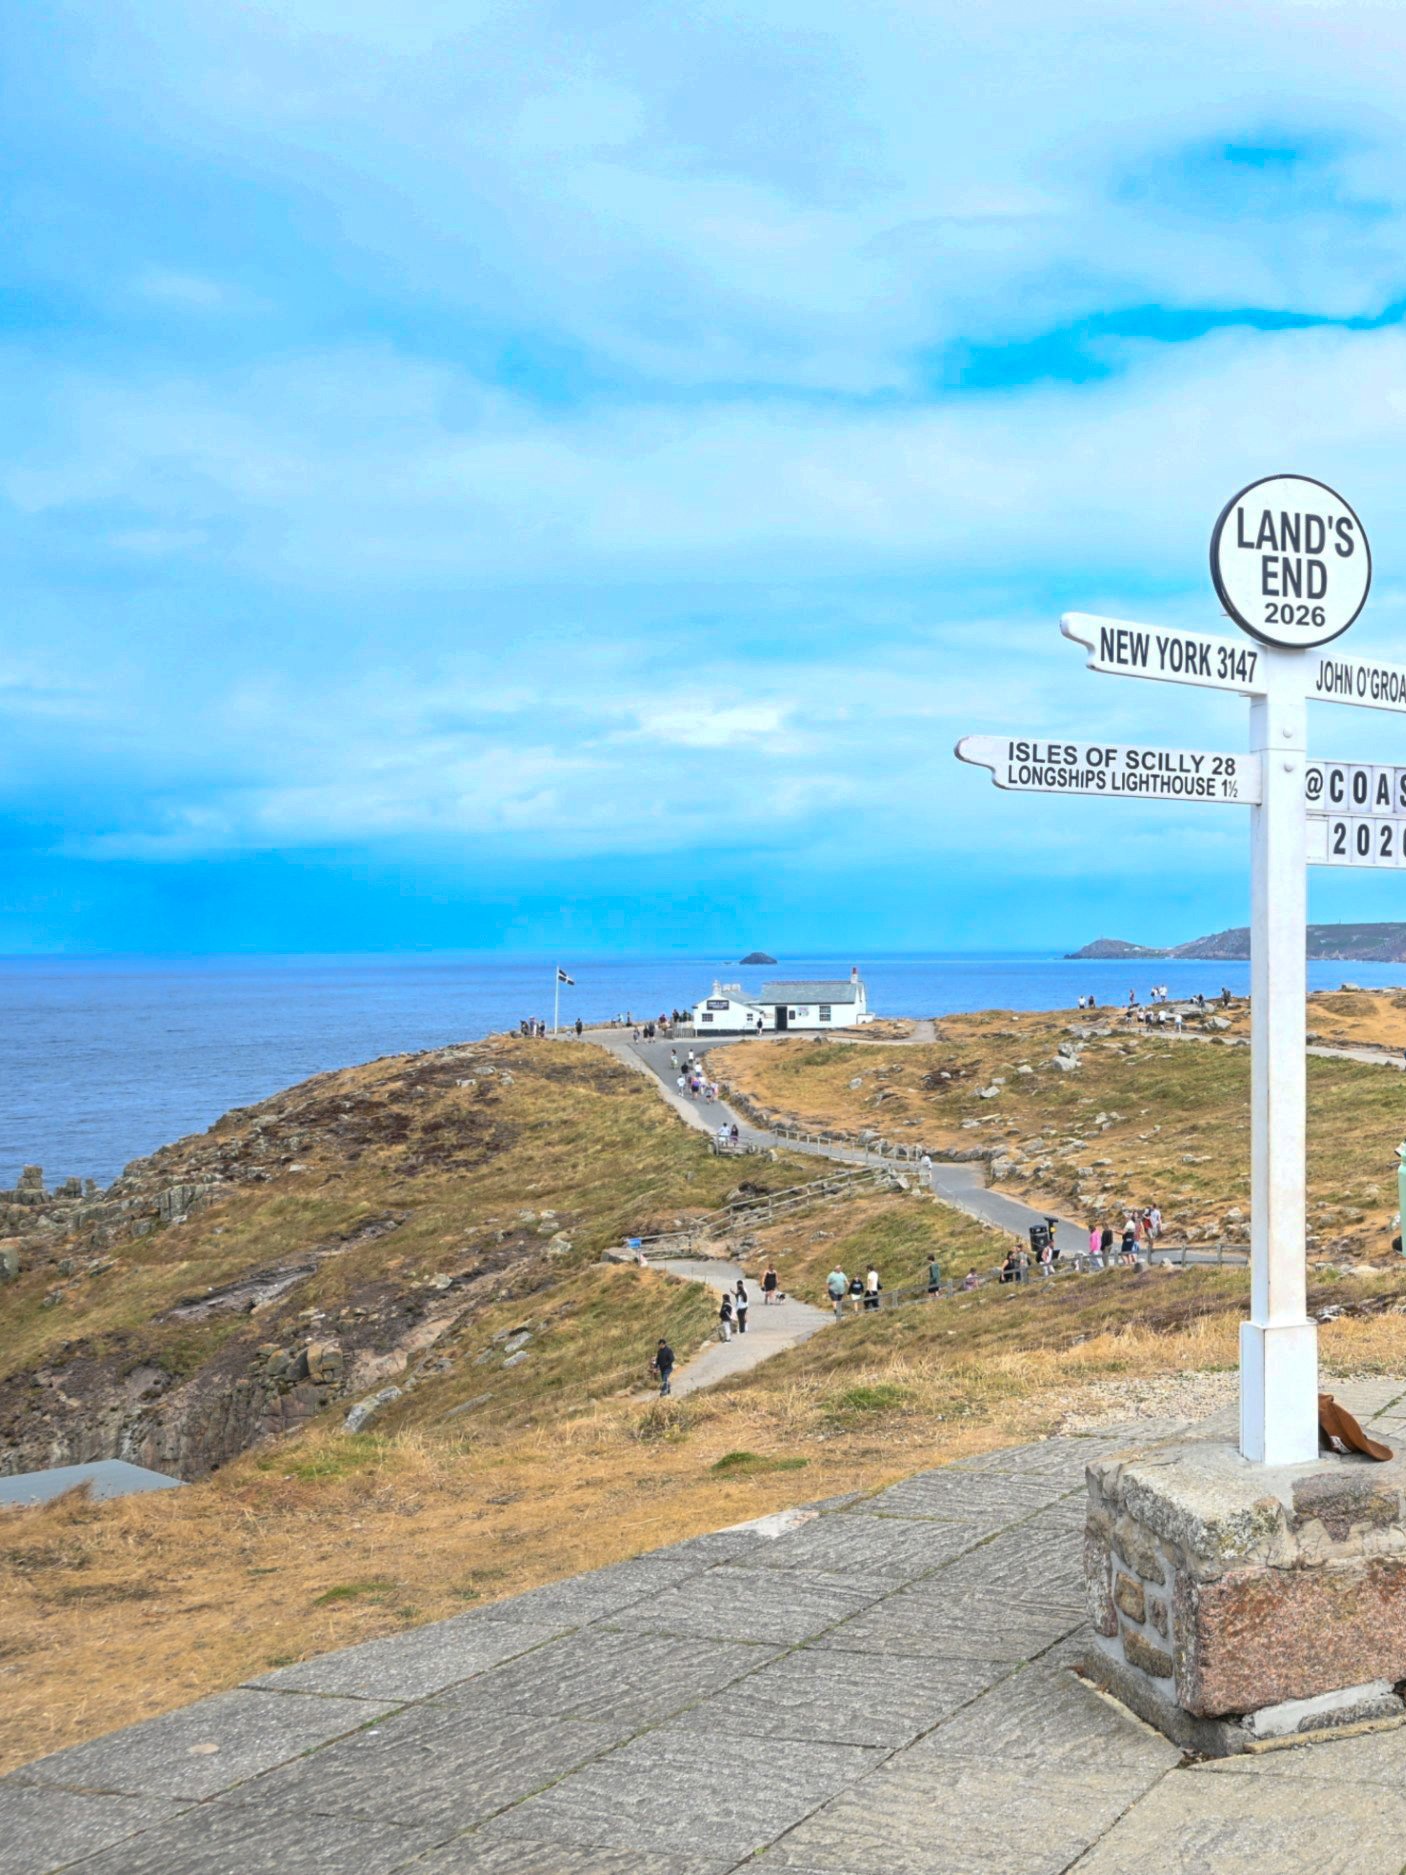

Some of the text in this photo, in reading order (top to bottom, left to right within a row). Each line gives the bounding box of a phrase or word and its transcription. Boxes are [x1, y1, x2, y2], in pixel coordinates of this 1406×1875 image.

[1237, 506, 1355, 558] LAND'S
[1261, 555, 1328, 600] END
[1264, 602, 1326, 627] 2026
[1100, 626, 1258, 683] NEW YORK 3147
[1316, 659, 1353, 695] JOHN
[1008, 741, 1236, 776] ISLES OF SCILLY 28
[1008, 764, 1106, 790] LONGSHIPS
[1111, 771, 1216, 797] LIGHTHOUSE
